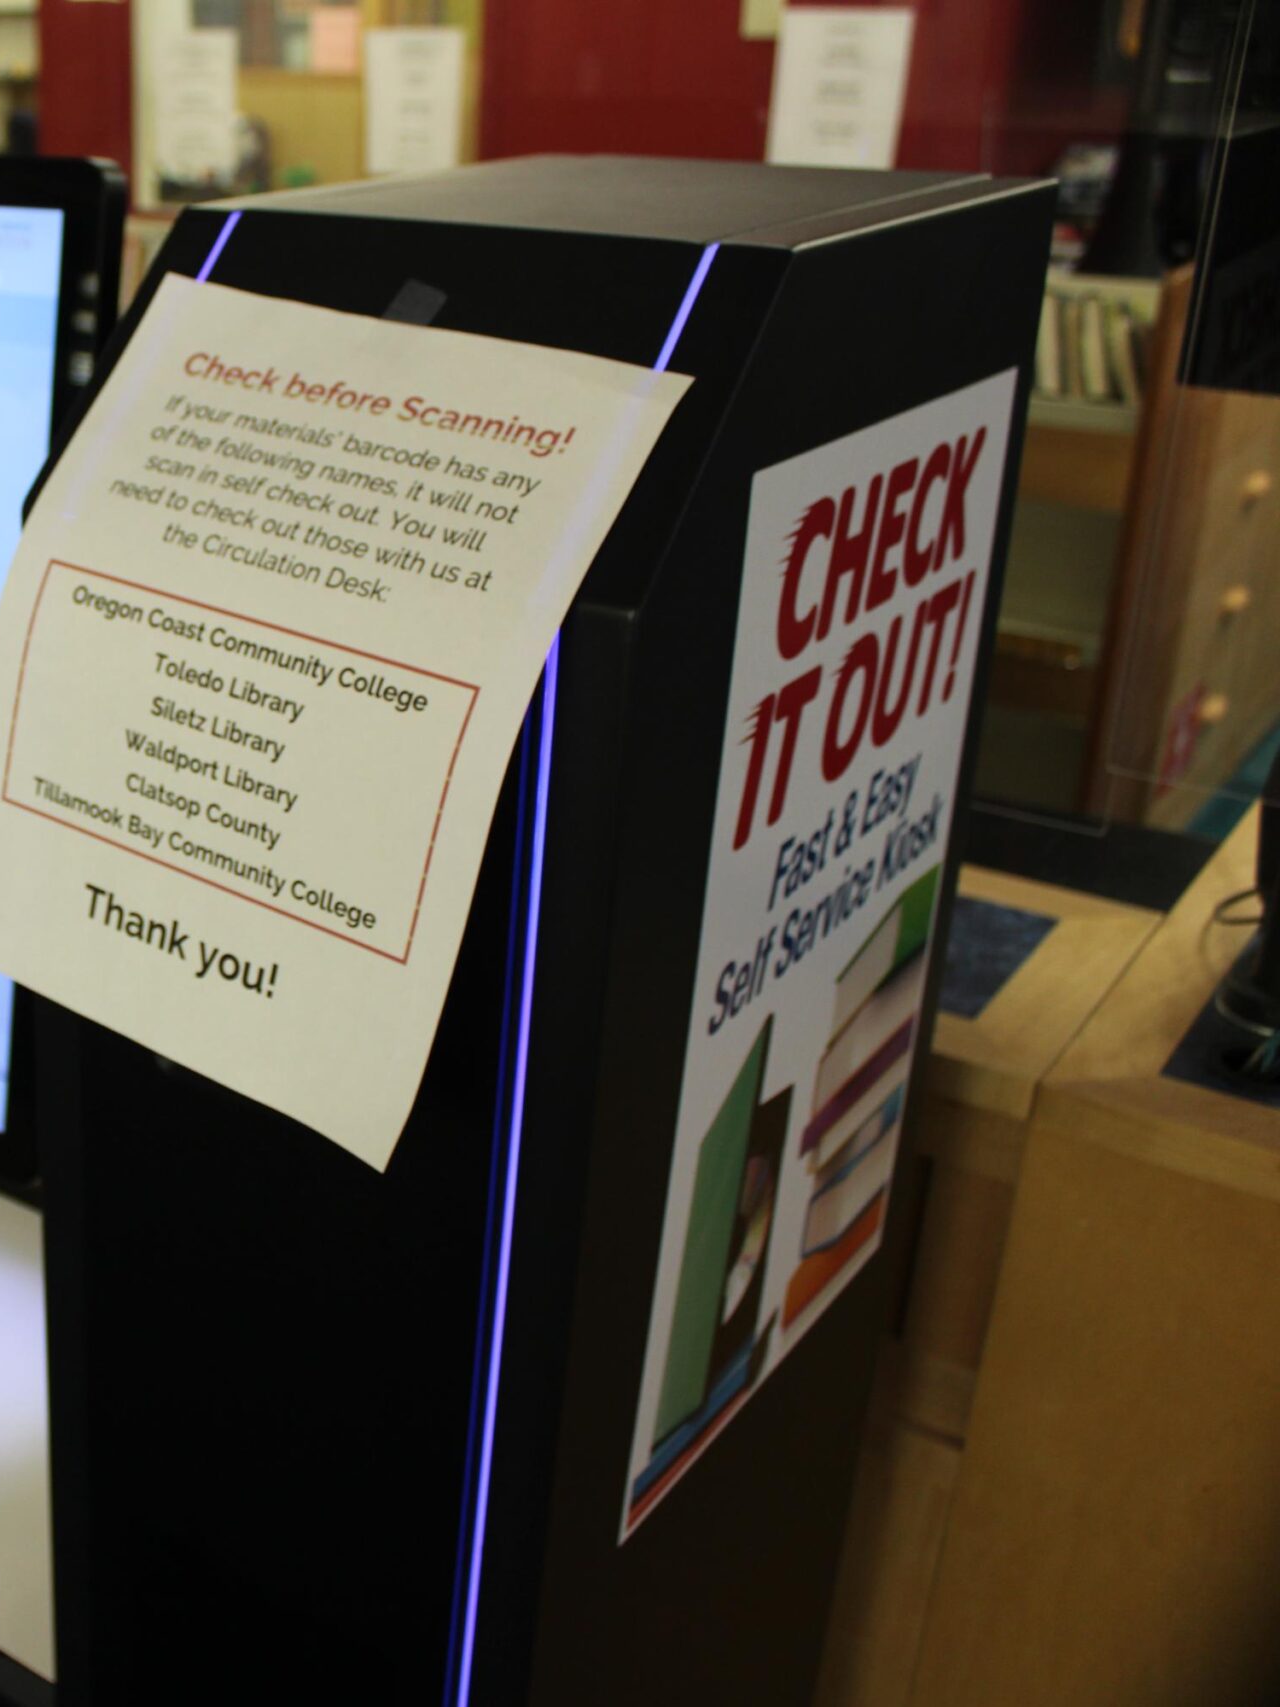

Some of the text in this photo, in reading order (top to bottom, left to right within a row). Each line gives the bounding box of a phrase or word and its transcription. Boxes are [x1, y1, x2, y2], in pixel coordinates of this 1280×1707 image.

[165, 394, 185, 412] If
[180, 399, 232, 423] your
[343, 434, 440, 472] barcode
[443, 455, 489, 482] has
[492, 474, 542, 498] any
[184, 353, 576, 458] Check before Scanning!
[144, 454, 488, 552] scan in self check out. You will
[150, 424, 520, 524] of the following names, it will not
[109, 478, 492, 591] need to check out those with us at
[162, 523, 199, 549] the
[203, 534, 321, 583] Circulation
[775, 425, 987, 662] CHECK
[72, 585, 429, 712] Oregon Coast Community College
[154, 652, 305, 723] Toledo Library
[150, 696, 286, 763] Siletz Library
[733, 568, 976, 851] IT OUT!
[125, 729, 298, 813] Waldport Library
[125, 773, 281, 850] Clatsop County
[33, 777, 377, 929] Tillamook Bay Community College
[767, 752, 922, 912] Fast & Easy
[85, 882, 279, 999] Thank you!
[708, 791, 944, 1036] Self Service Kiosk
